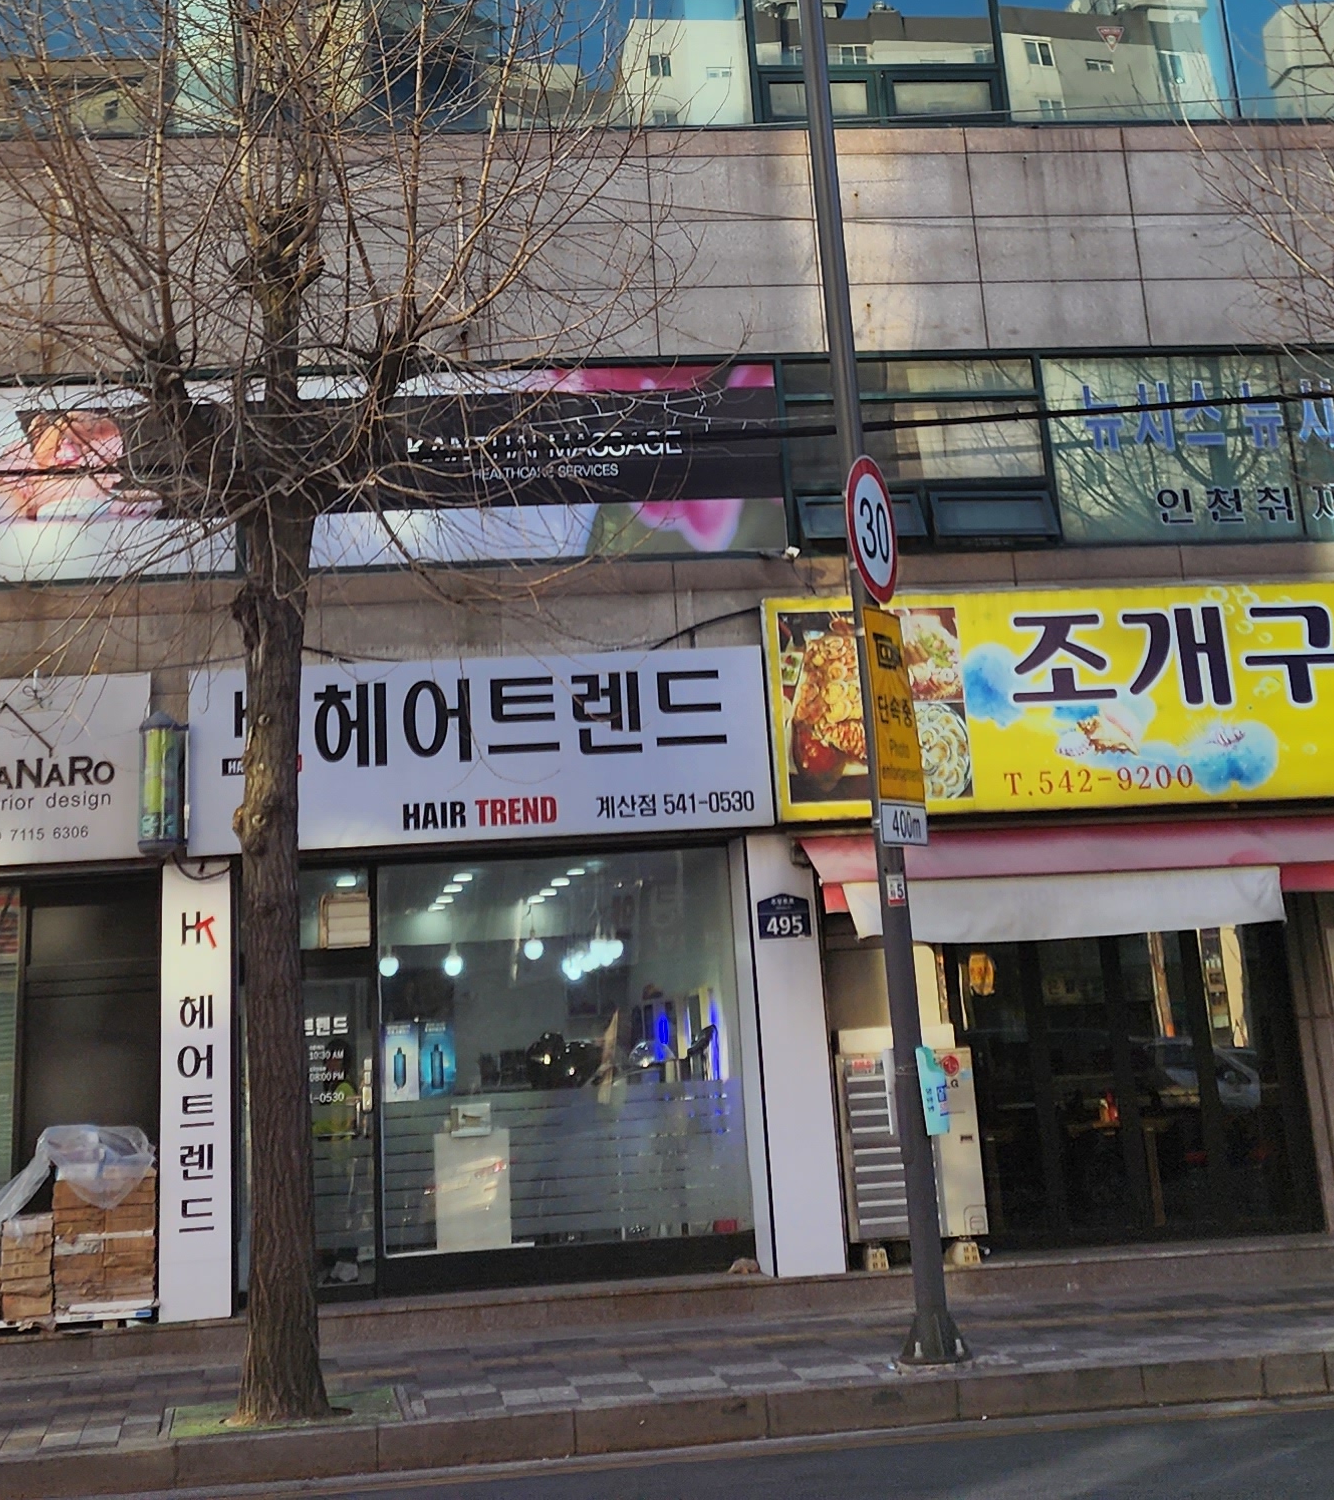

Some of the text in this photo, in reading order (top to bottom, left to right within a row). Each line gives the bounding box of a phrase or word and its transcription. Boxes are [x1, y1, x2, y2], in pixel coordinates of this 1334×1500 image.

[860, 496, 890, 564] 30
[313, 668, 728, 768] 헤어트렌드
[1003, 764, 1194, 797] T.542-9200
[46, 792, 112, 811] design
[403, 796, 559, 831] HAIR TREND
[596, 789, 756, 820] 계산점 541-0530
[10, 827, 46, 842] 7115
[53, 825, 90, 839] 6306
[892, 809, 922, 839] 400m
[766, 915, 803, 935] 495
[176, 994, 215, 1233] 헤어트렌드
